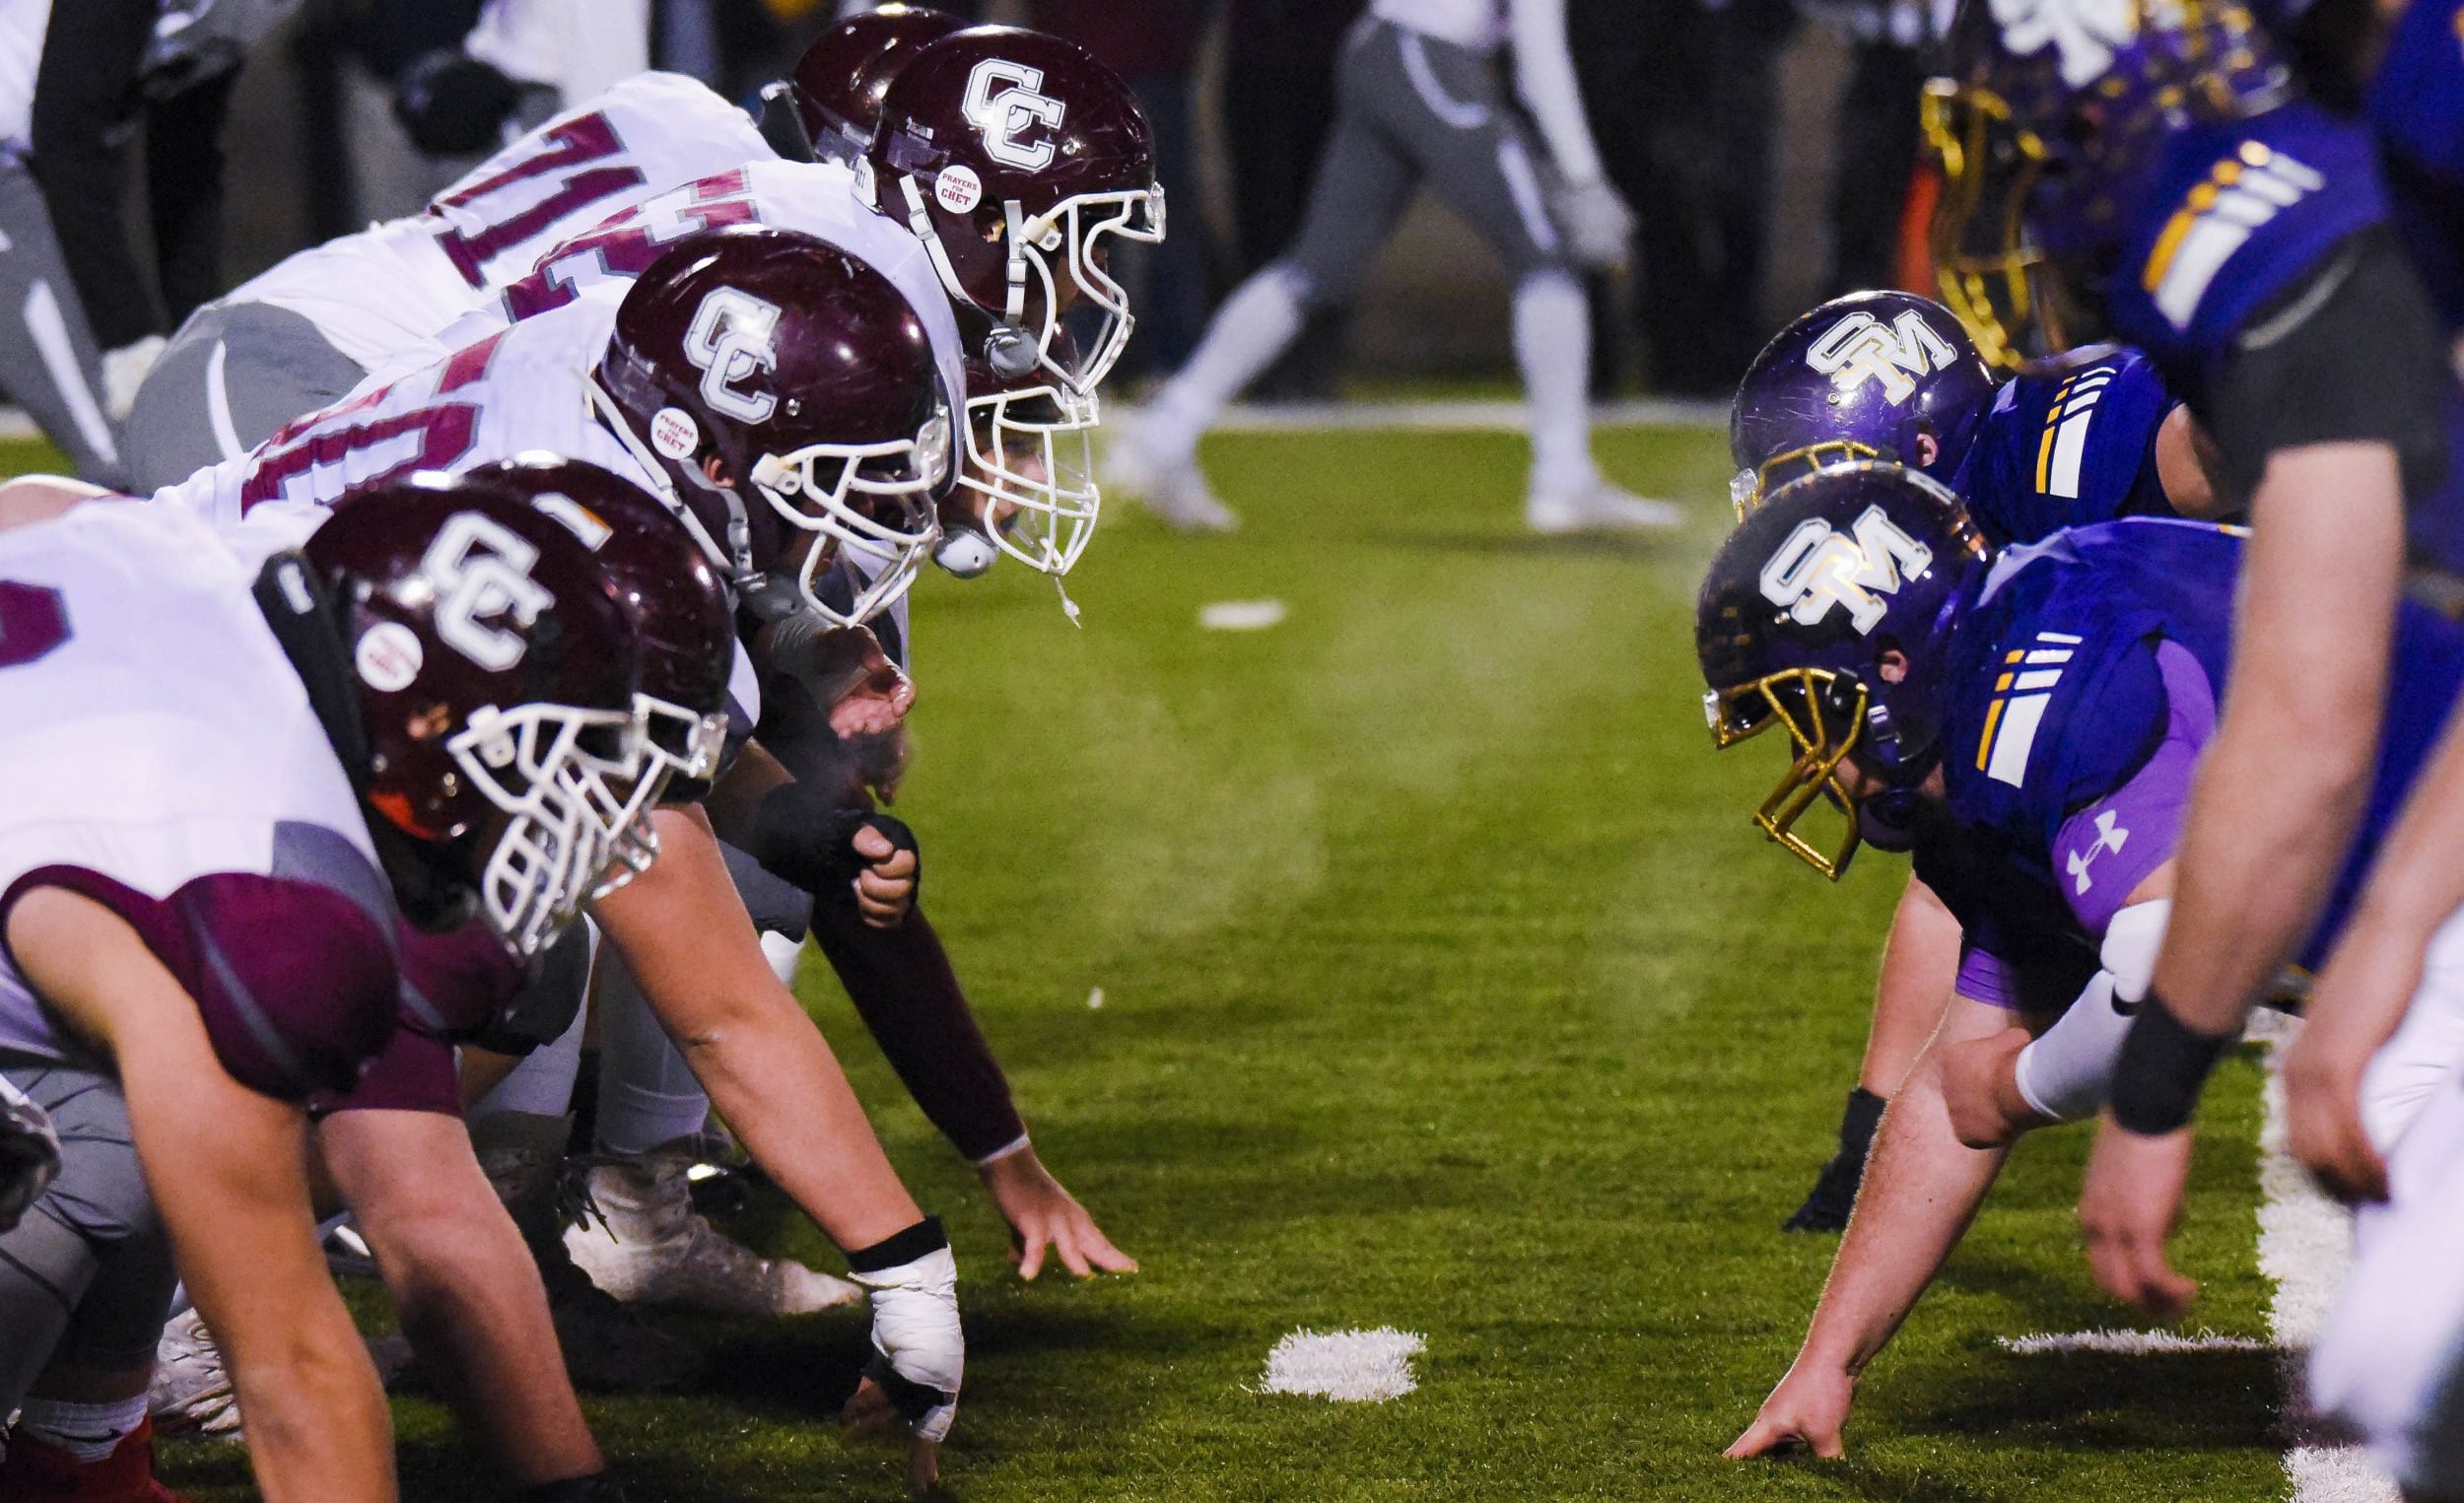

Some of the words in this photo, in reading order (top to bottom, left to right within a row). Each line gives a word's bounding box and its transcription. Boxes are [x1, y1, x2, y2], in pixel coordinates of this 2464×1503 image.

[962, 58, 1065, 171] CC
[428, 108, 649, 292] 71
[941, 188, 971, 205] CHET
[942, 172, 977, 190] PRAYERS
[683, 285, 783, 426] CC
[421, 510, 556, 672] CC
